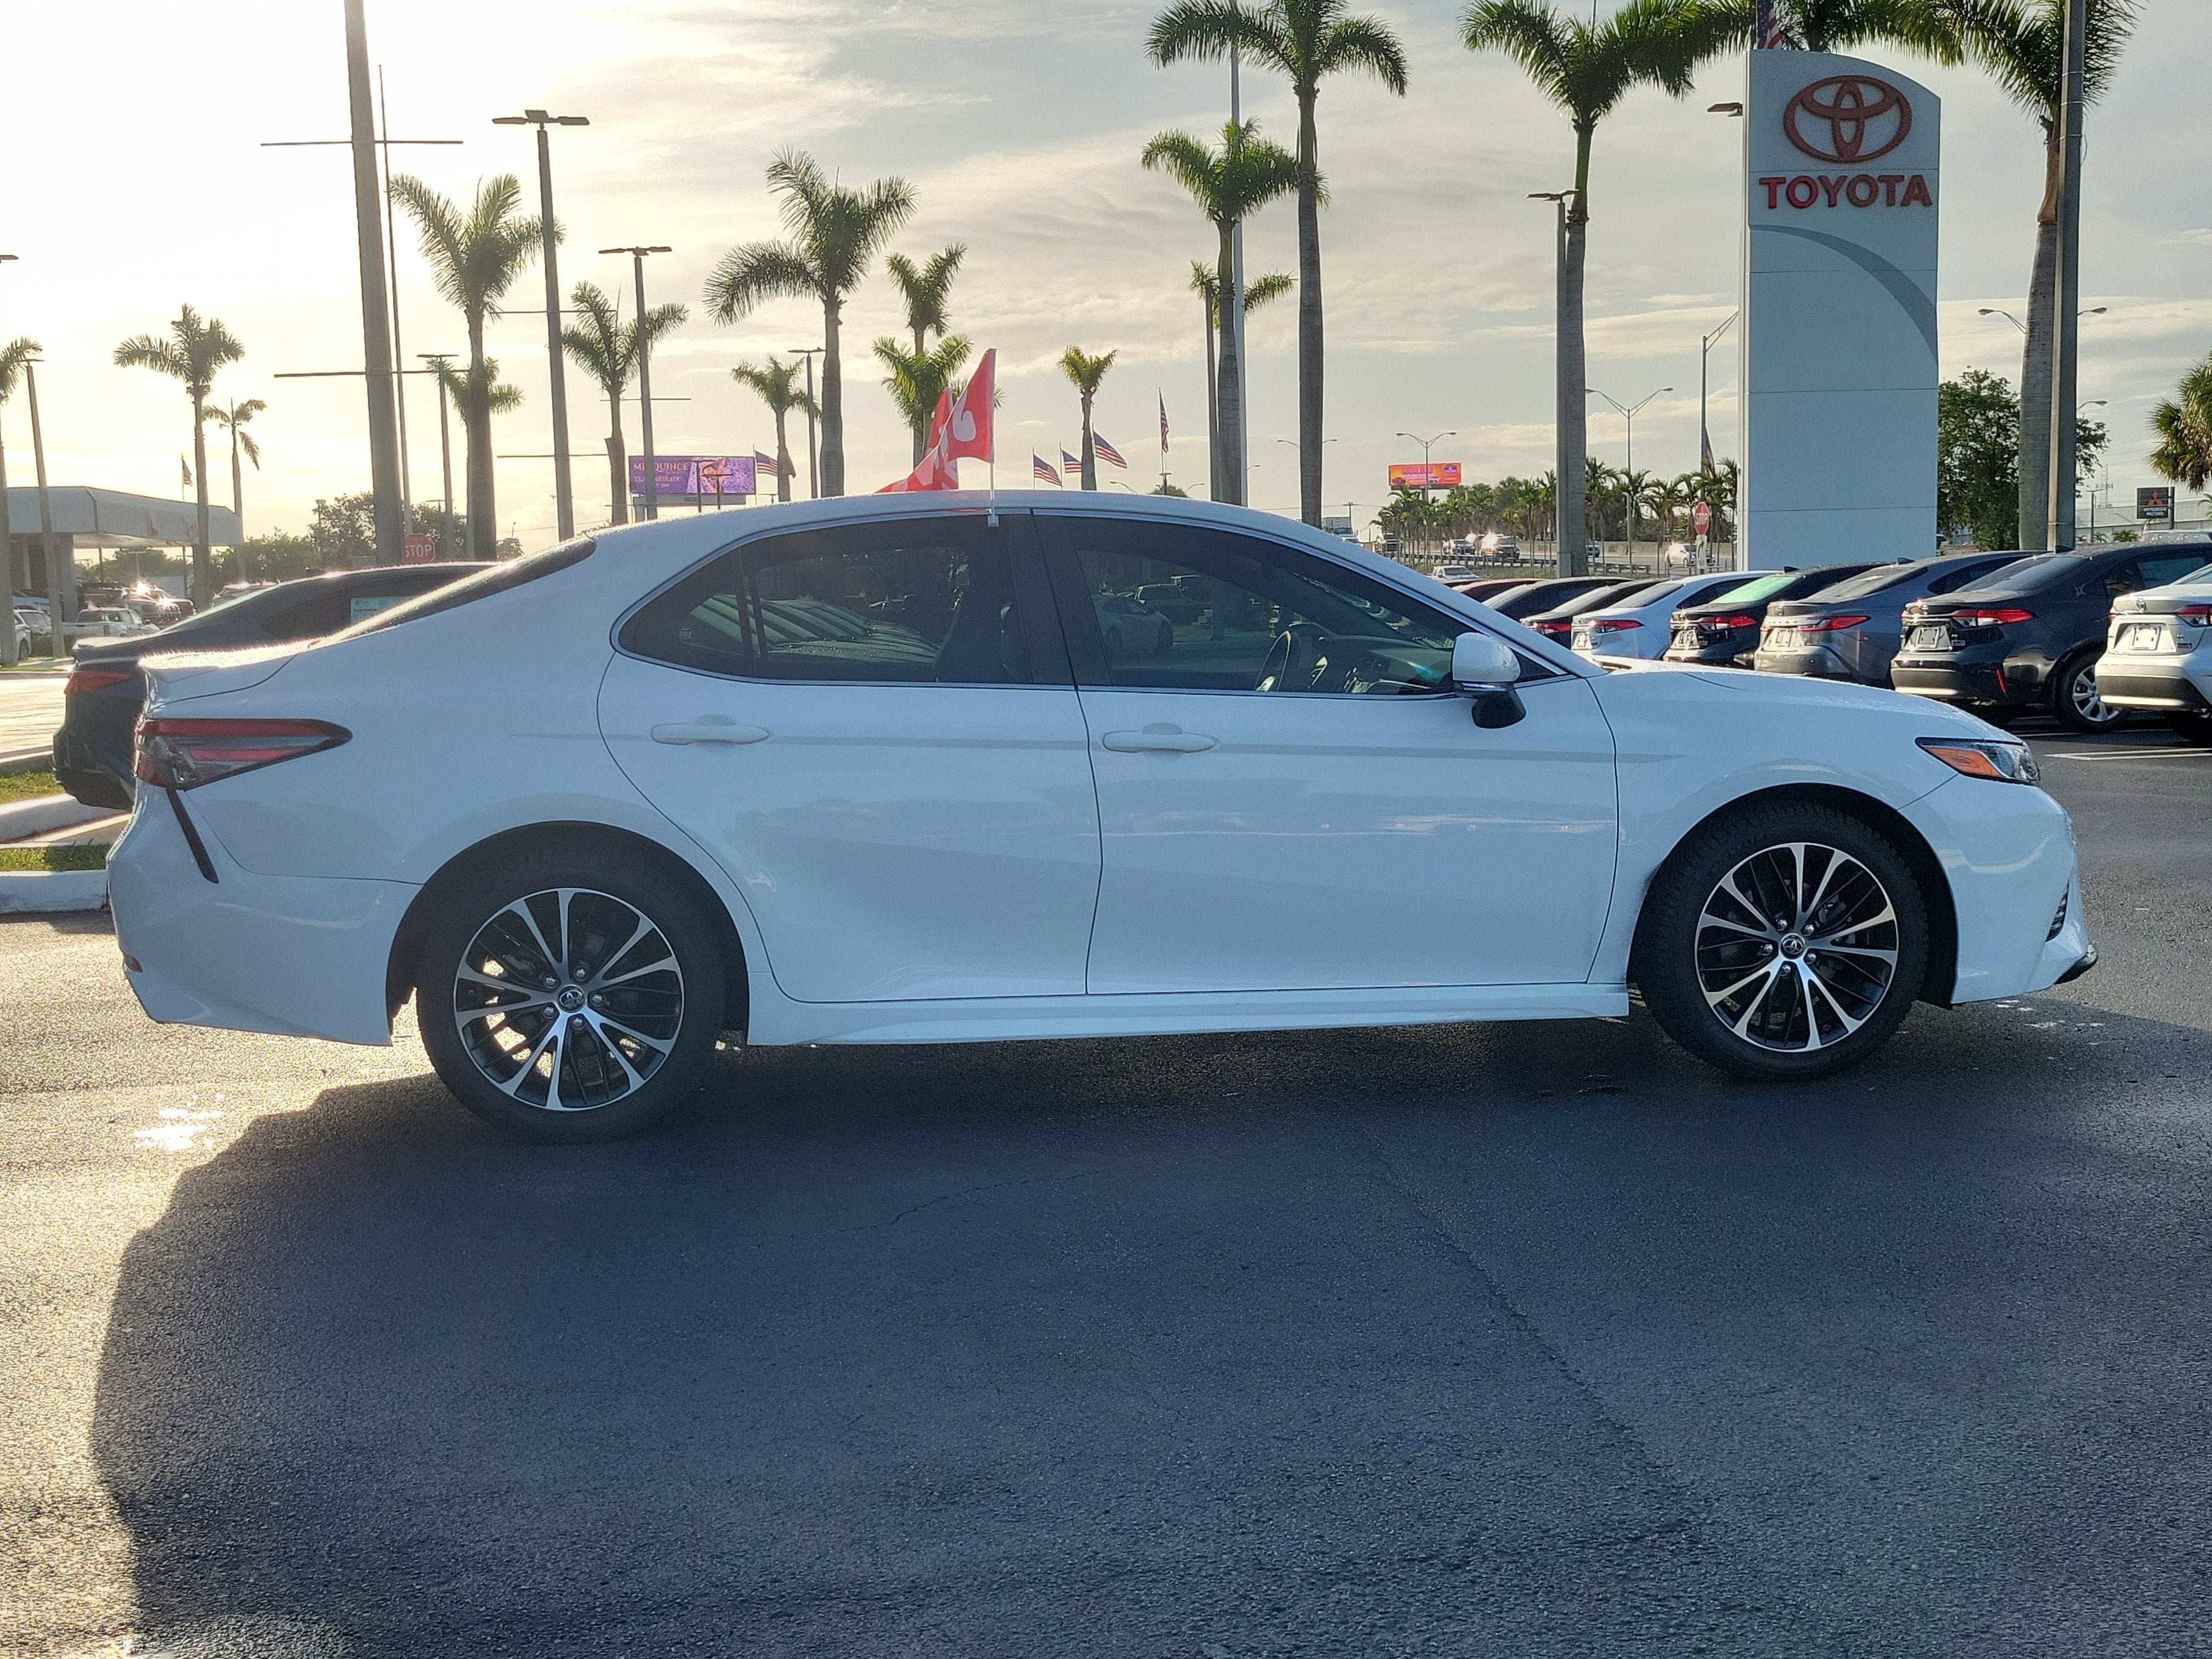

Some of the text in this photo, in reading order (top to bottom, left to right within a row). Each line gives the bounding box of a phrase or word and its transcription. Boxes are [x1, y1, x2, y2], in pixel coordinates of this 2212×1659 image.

[1759, 174, 1933, 209] TOYOTA
[1696, 512, 1708, 525] STOP
[405, 544, 432, 557] STOP
